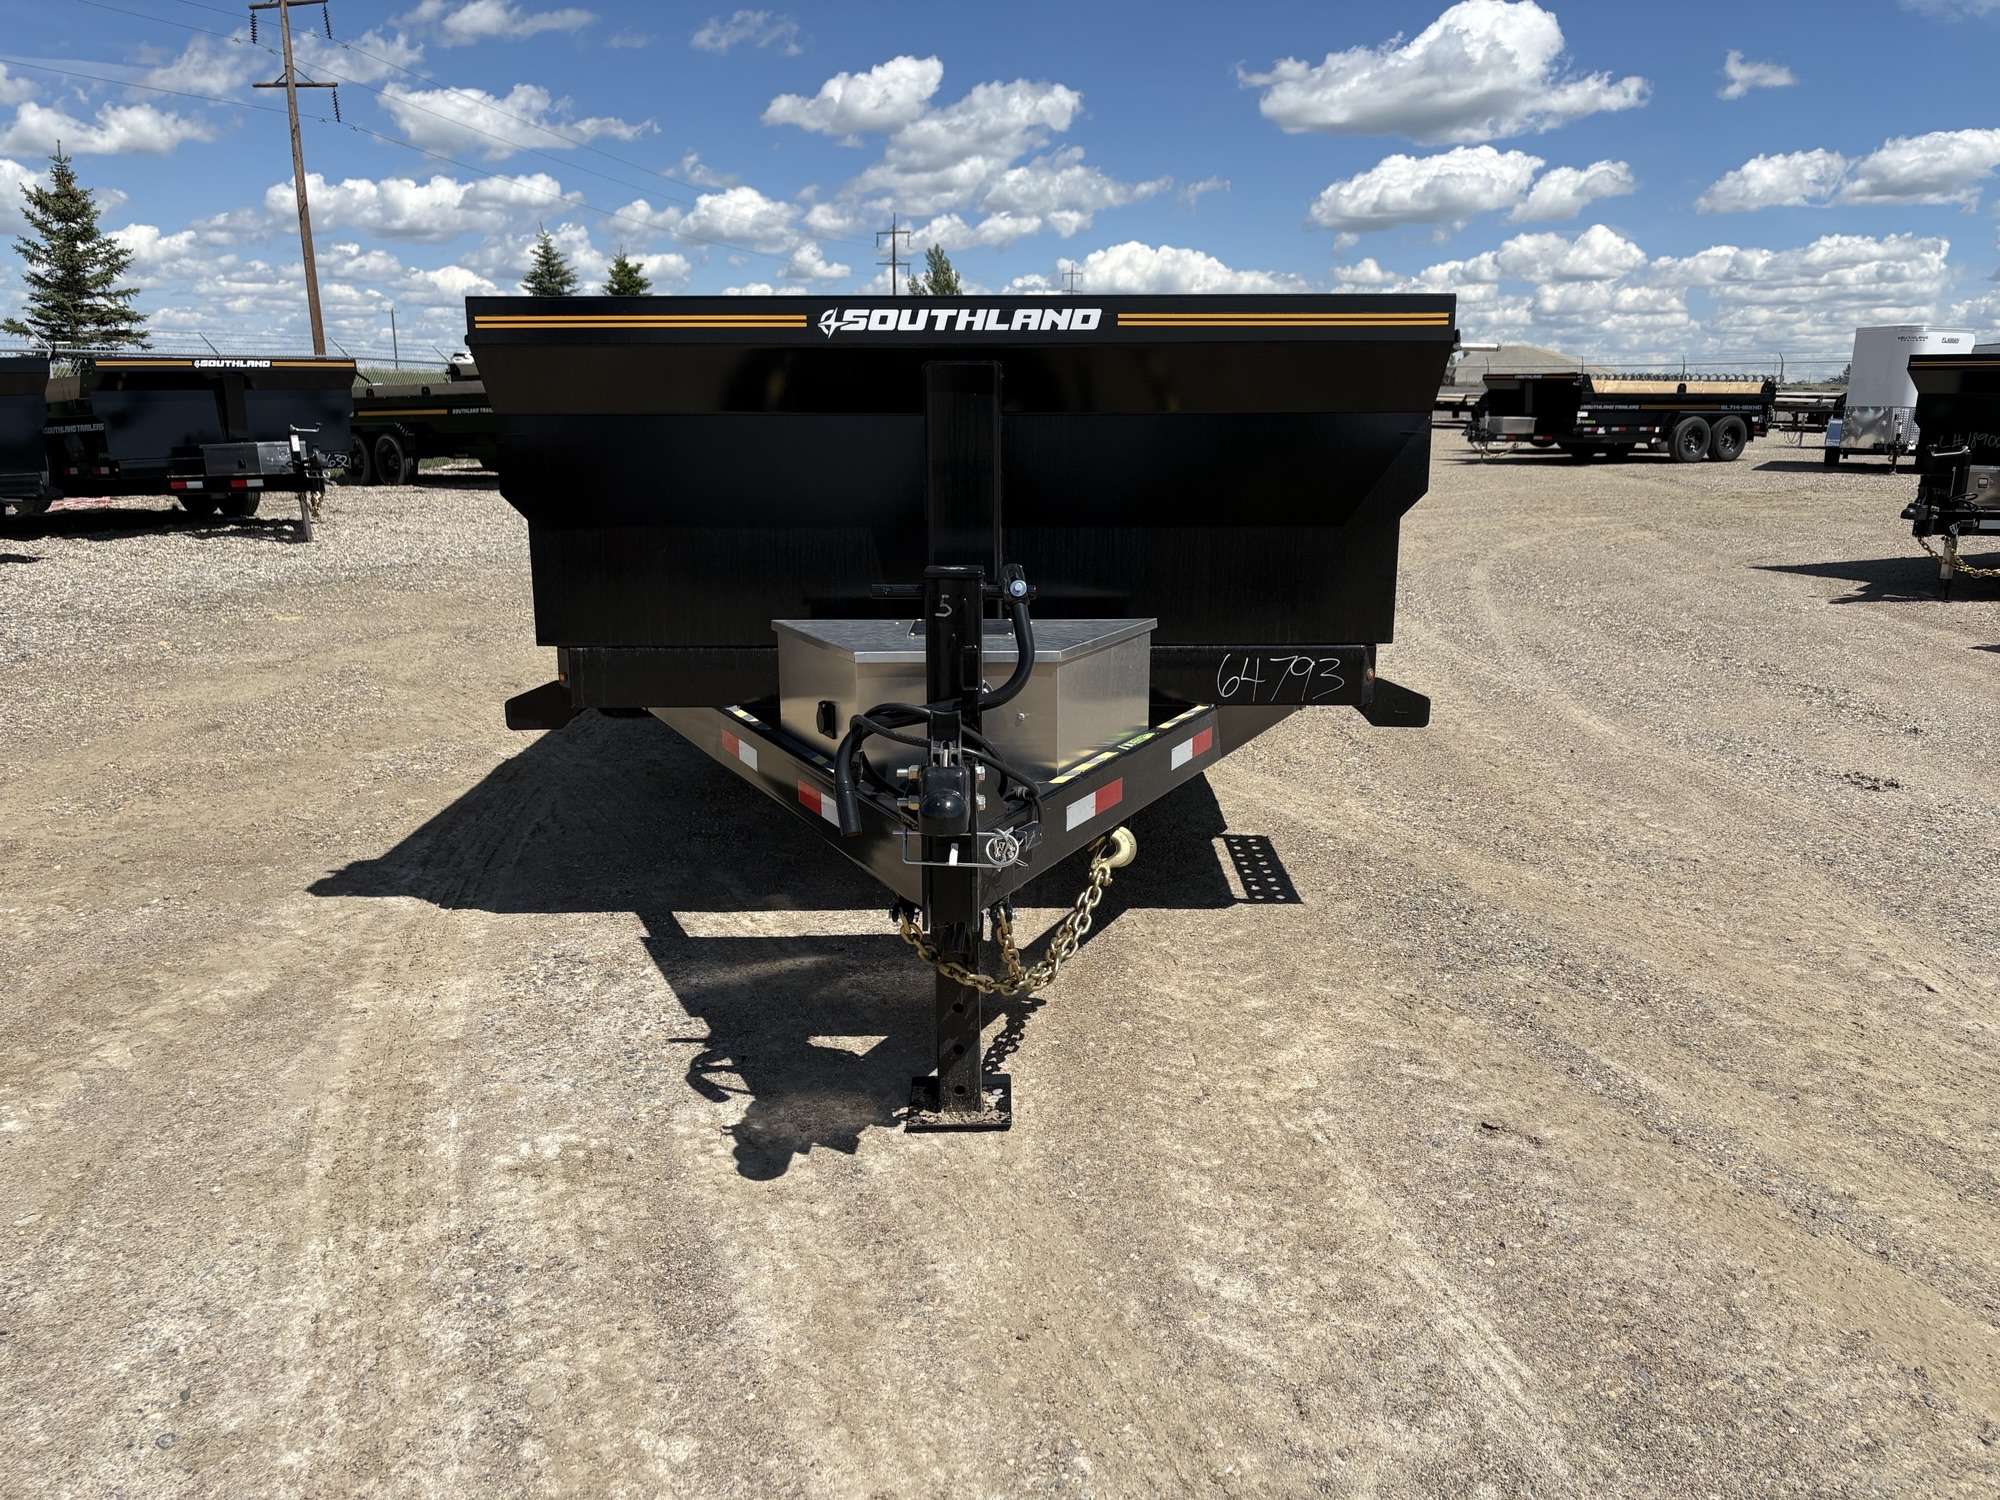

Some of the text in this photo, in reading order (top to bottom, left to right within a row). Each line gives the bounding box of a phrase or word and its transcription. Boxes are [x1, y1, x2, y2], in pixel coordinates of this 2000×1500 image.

[840, 309, 1102, 331] SOUTHLAND
[935, 594, 952, 617] 5
[1217, 653, 1345, 702] 64793
